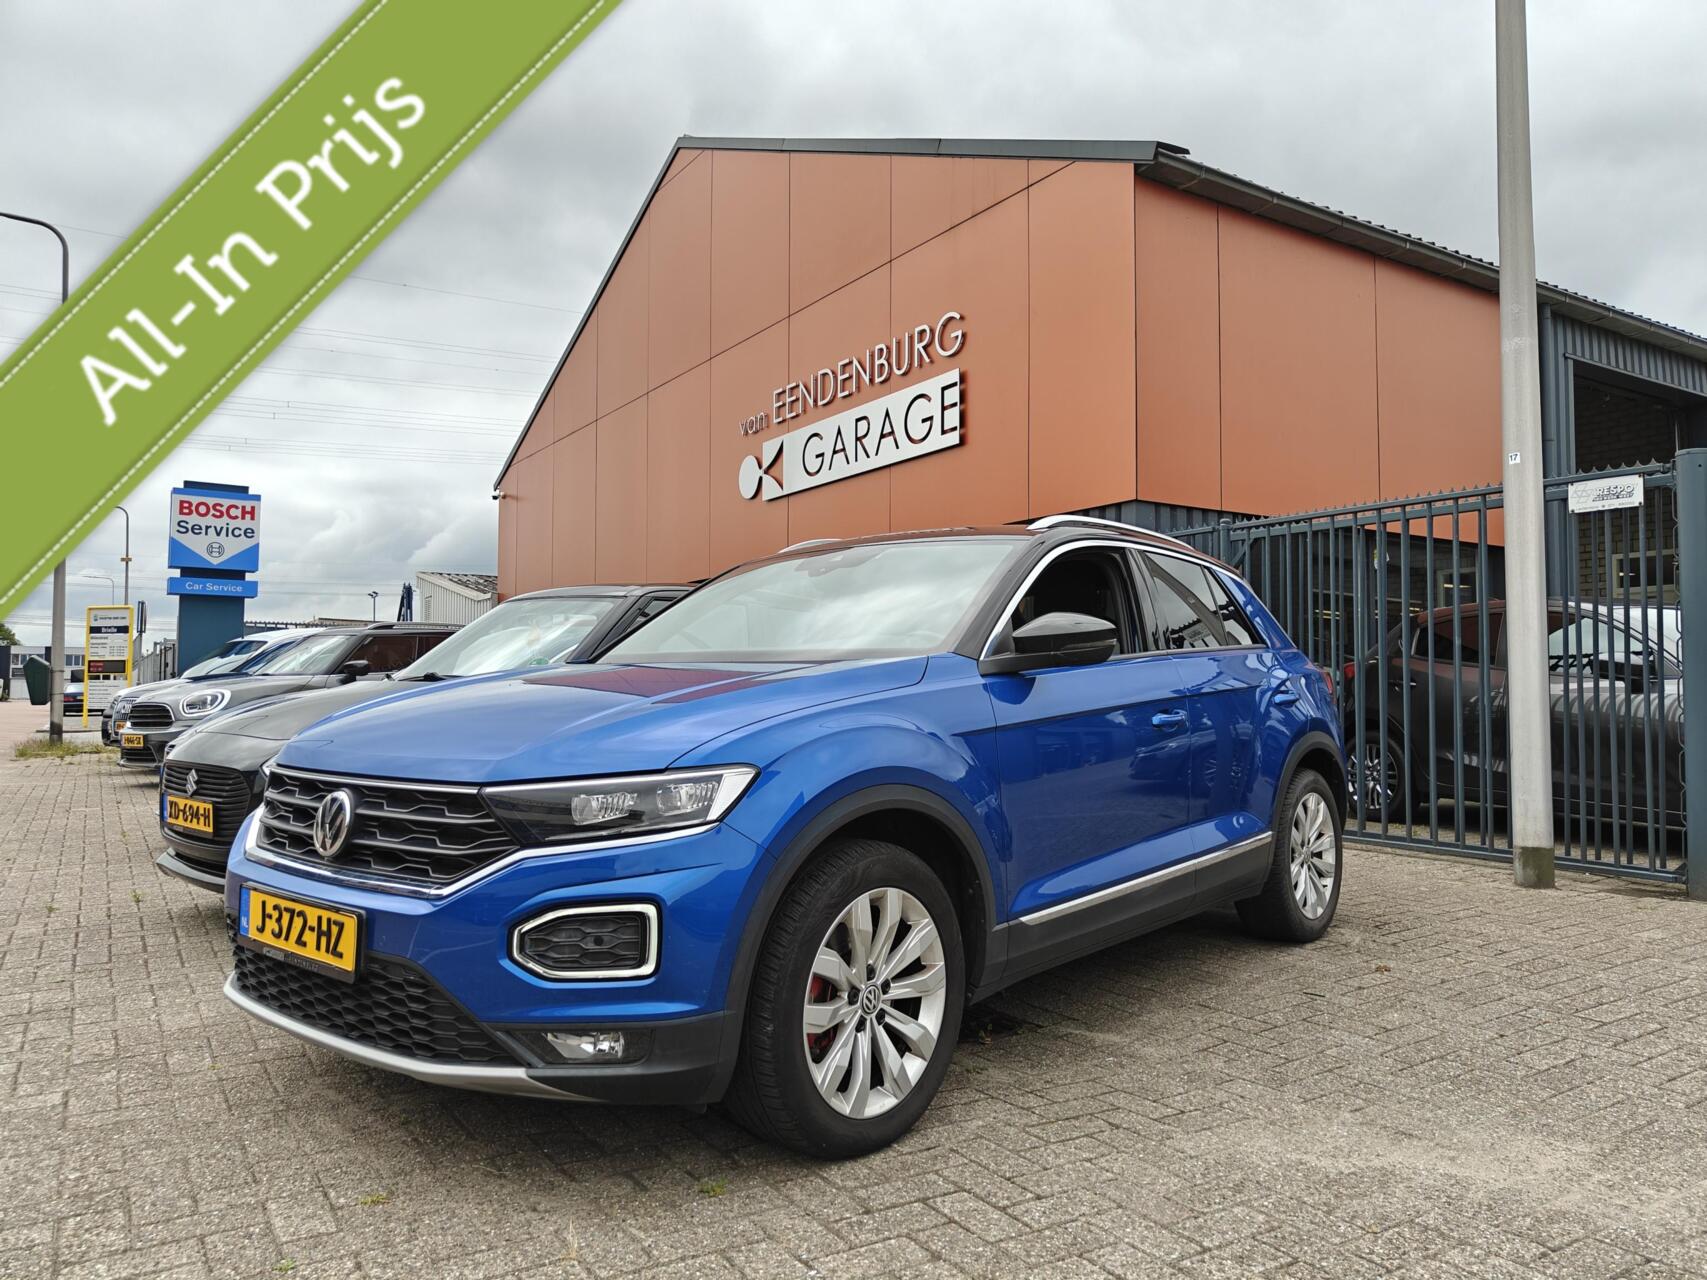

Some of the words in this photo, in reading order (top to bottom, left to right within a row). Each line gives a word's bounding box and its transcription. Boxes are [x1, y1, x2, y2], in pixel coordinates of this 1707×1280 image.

[739, 411, 769, 436] van
[773, 311, 965, 425] EENDENBURG
[801, 380, 959, 477] GARAGE
[1509, 453, 1519, 462] 17
[178, 499, 256, 521] BOSCH
[176, 519, 256, 539] Service
[185, 581, 203, 591] Car
[206, 582, 243, 592] Service
[168, 799, 211, 828] XD-694-H
[255, 899, 345, 960] J-372-HZ
